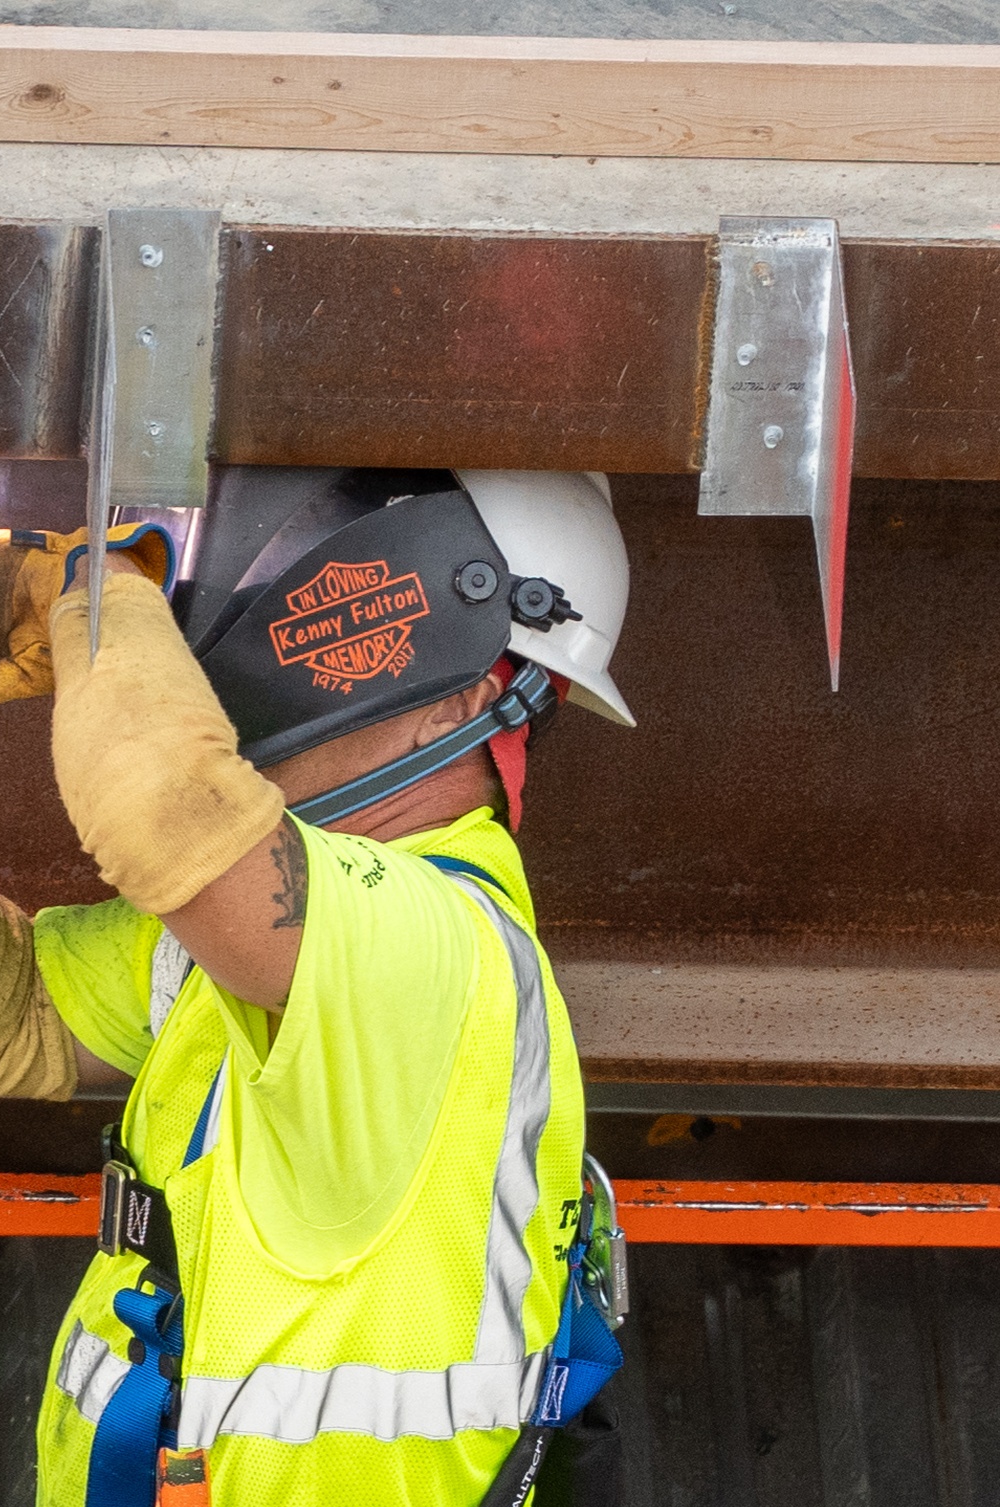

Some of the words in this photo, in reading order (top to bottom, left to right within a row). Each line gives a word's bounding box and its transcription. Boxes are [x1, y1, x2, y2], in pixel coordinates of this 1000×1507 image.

[299, 592, 317, 610] IN
[317, 567, 379, 603] LOVING
[277, 614, 343, 651] Kenny
[350, 589, 419, 625] Fulton
[322, 629, 397, 673] MEMORY
[387, 641, 416, 679] 2017
[312, 671, 353, 695] 1974
